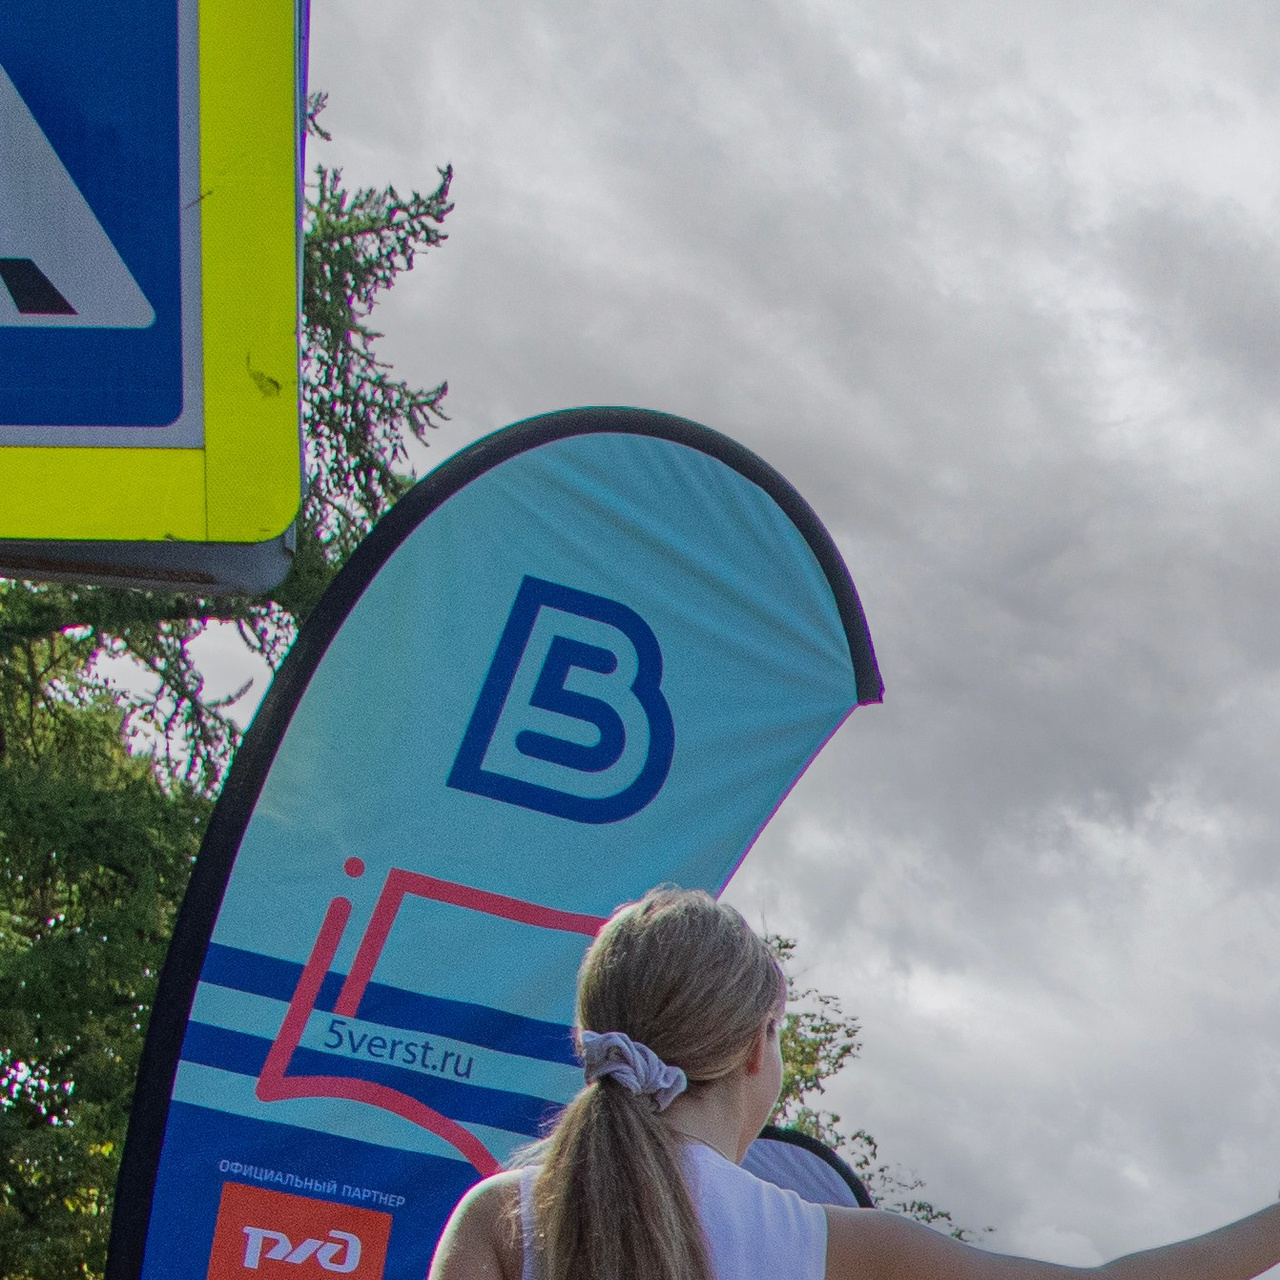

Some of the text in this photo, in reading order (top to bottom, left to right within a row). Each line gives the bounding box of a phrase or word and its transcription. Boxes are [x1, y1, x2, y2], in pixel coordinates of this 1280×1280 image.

[324, 1019, 474, 1079] 5verst.ru
[218, 1159, 406, 1208] ОФИЦИАЛЬНЫЙ ПАРТНЕР
